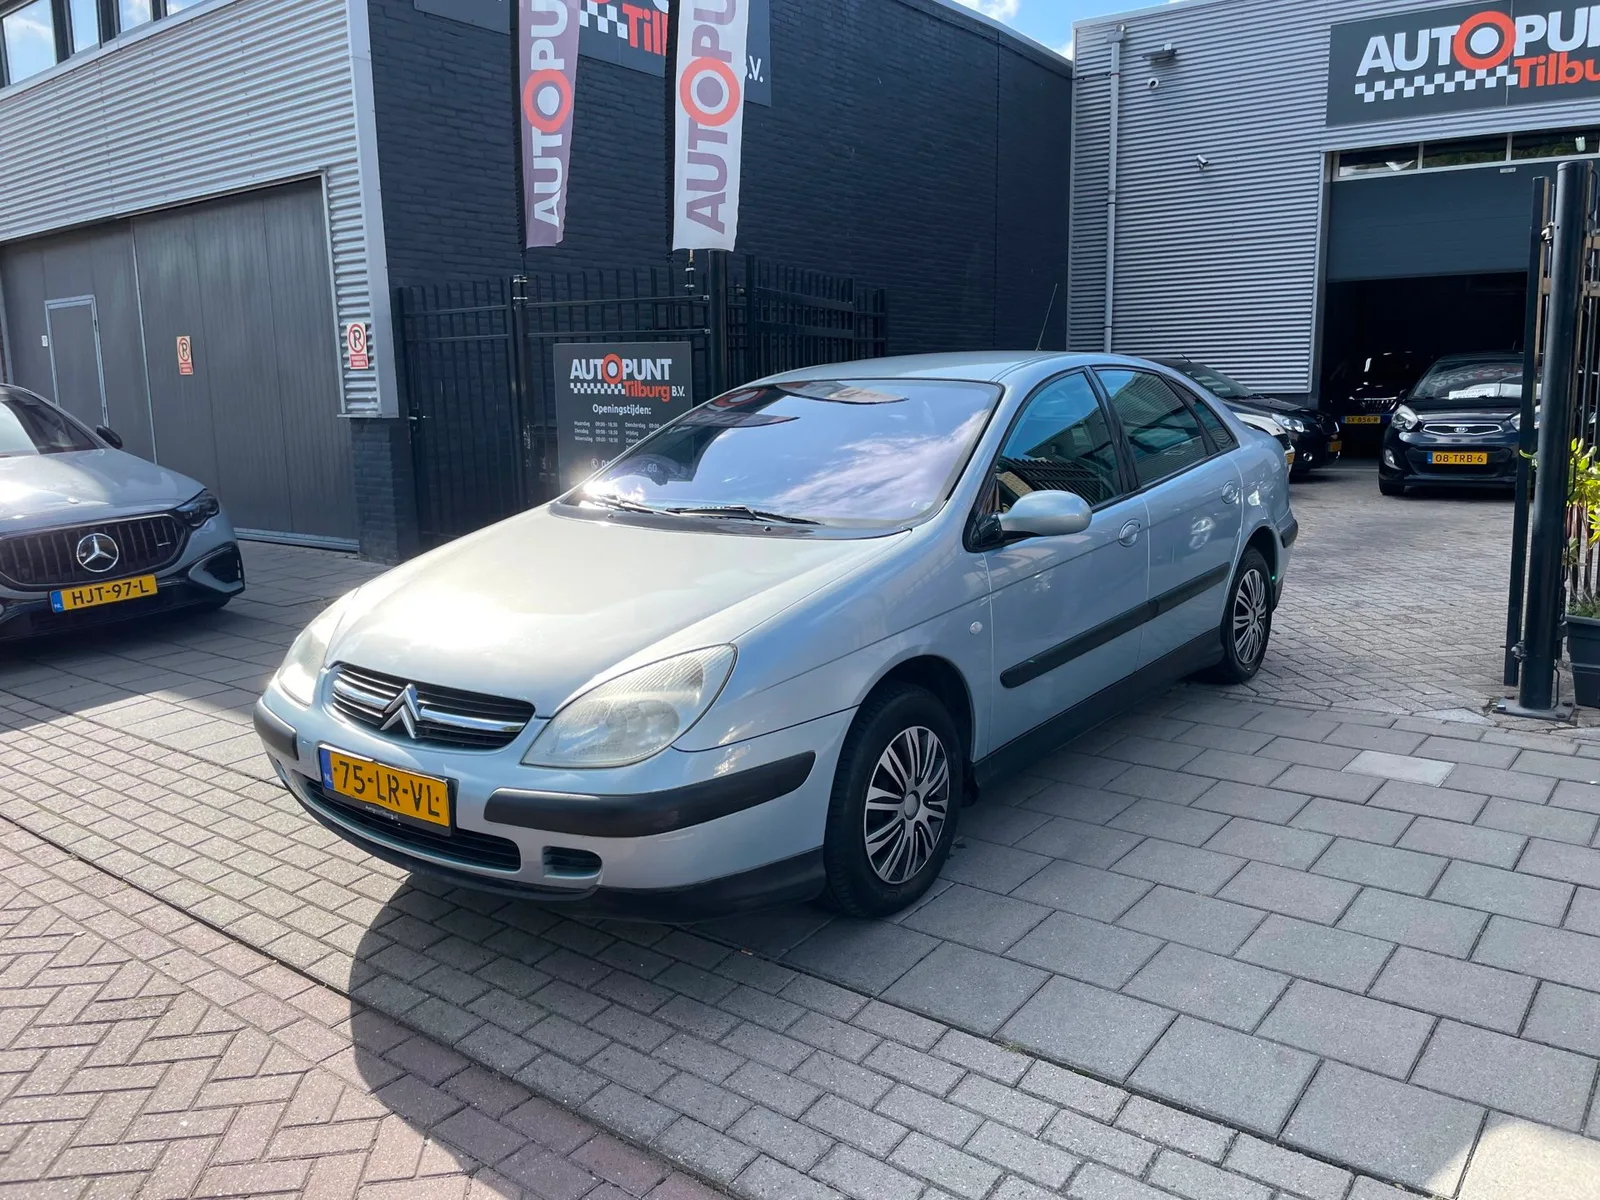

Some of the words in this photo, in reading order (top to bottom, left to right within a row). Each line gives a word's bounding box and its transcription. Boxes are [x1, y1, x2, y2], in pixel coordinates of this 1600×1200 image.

[1356, 6, 1600, 77] AUTOPU
[570, 353, 672, 385] AUTOPUNT
[623, 381, 671, 402] Tilburg
[672, 386, 685, 397] B.V.
[592, 404, 652, 415] Openingstijden:
[1435, 454, 1484, 463] 08-TRB-6
[72, 580, 149, 606] HJT-97-L
[338, 760, 440, 817] 75-LR-VL
